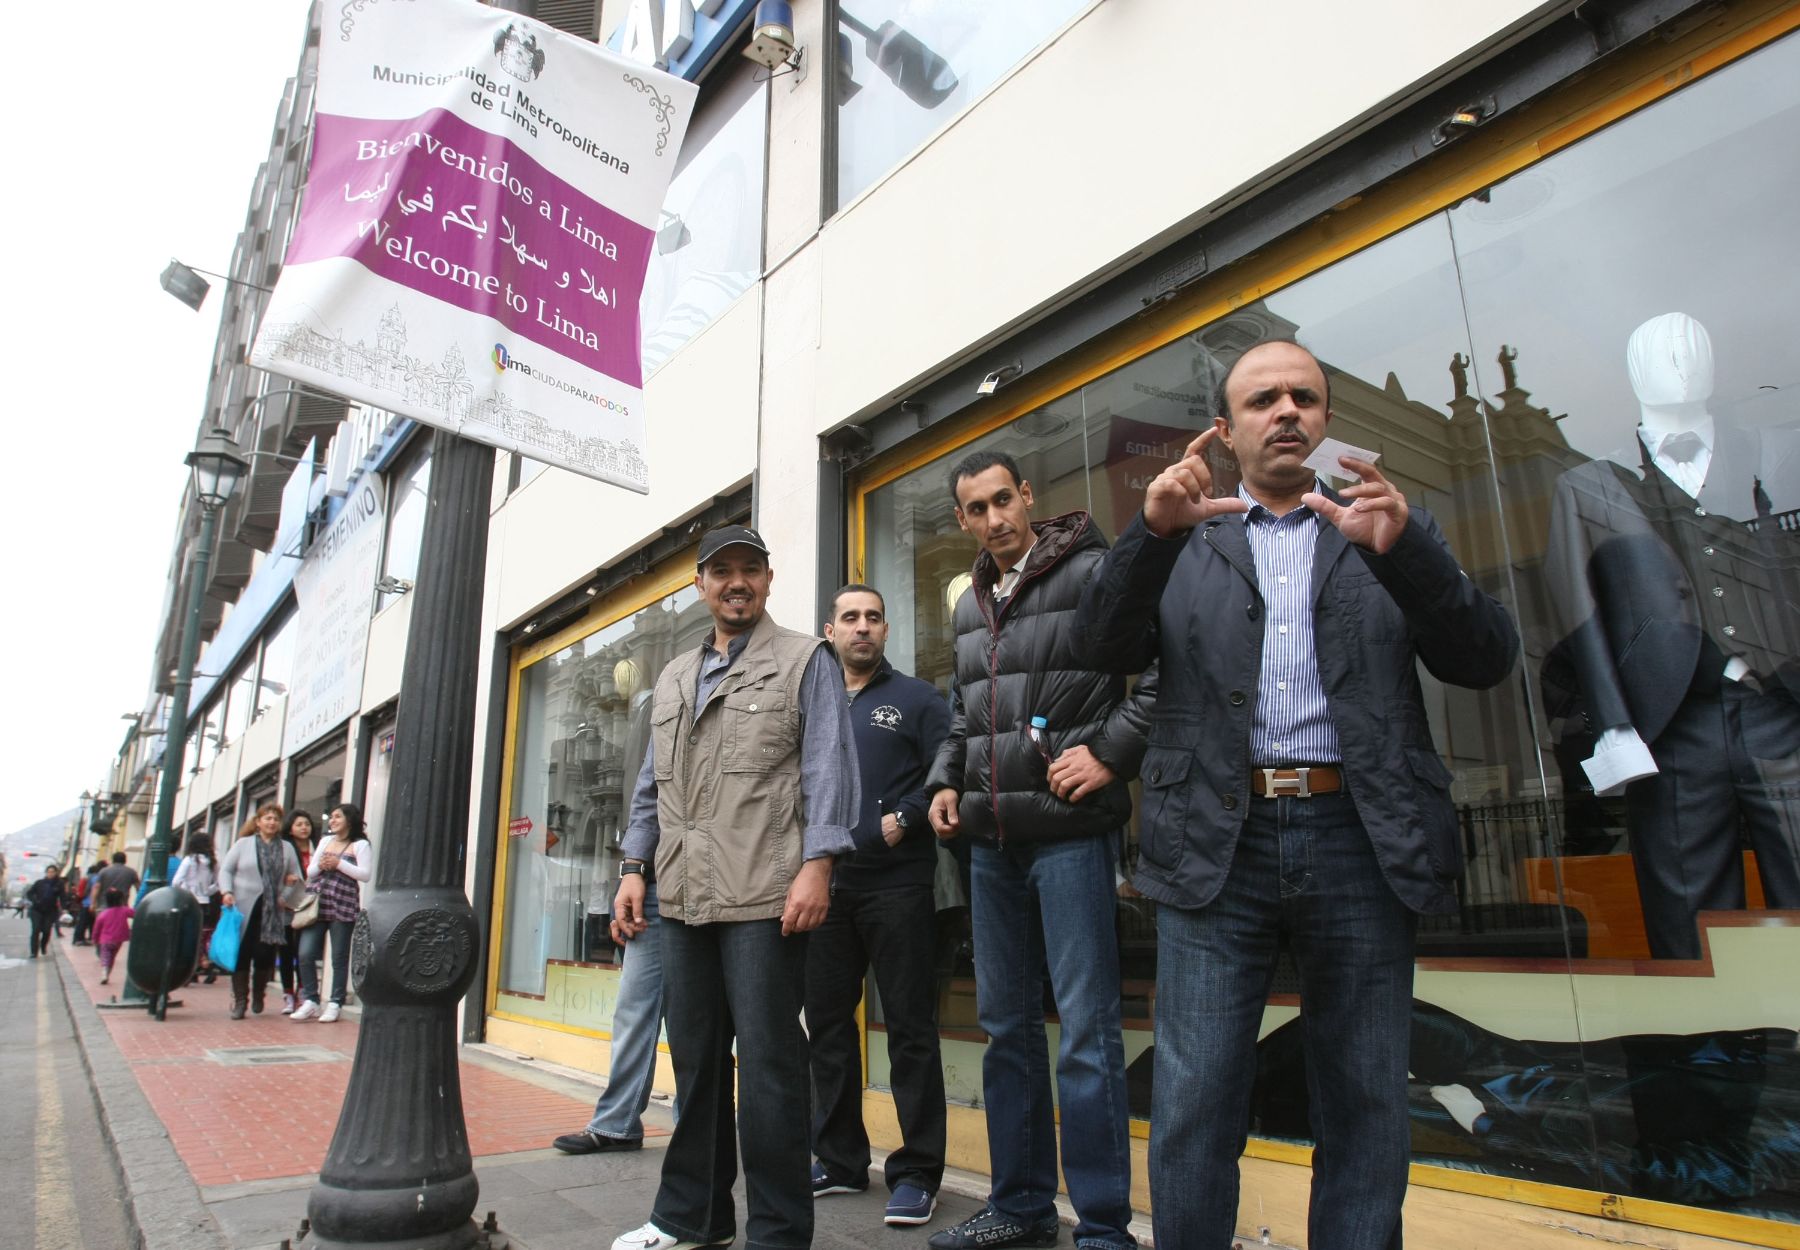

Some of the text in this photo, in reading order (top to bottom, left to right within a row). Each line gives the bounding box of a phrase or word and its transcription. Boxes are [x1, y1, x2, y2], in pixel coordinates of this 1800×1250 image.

[470, 88, 538, 140] de Lima
[516, 90, 631, 175] Metropolitana
[344, 172, 616, 309] اهلا و سهلا بكم في ليما
[356, 131, 618, 261] Bienvenidos a Lima
[357, 218, 600, 352] Welcome to Lima
[320, 485, 376, 566] FEMENINO
